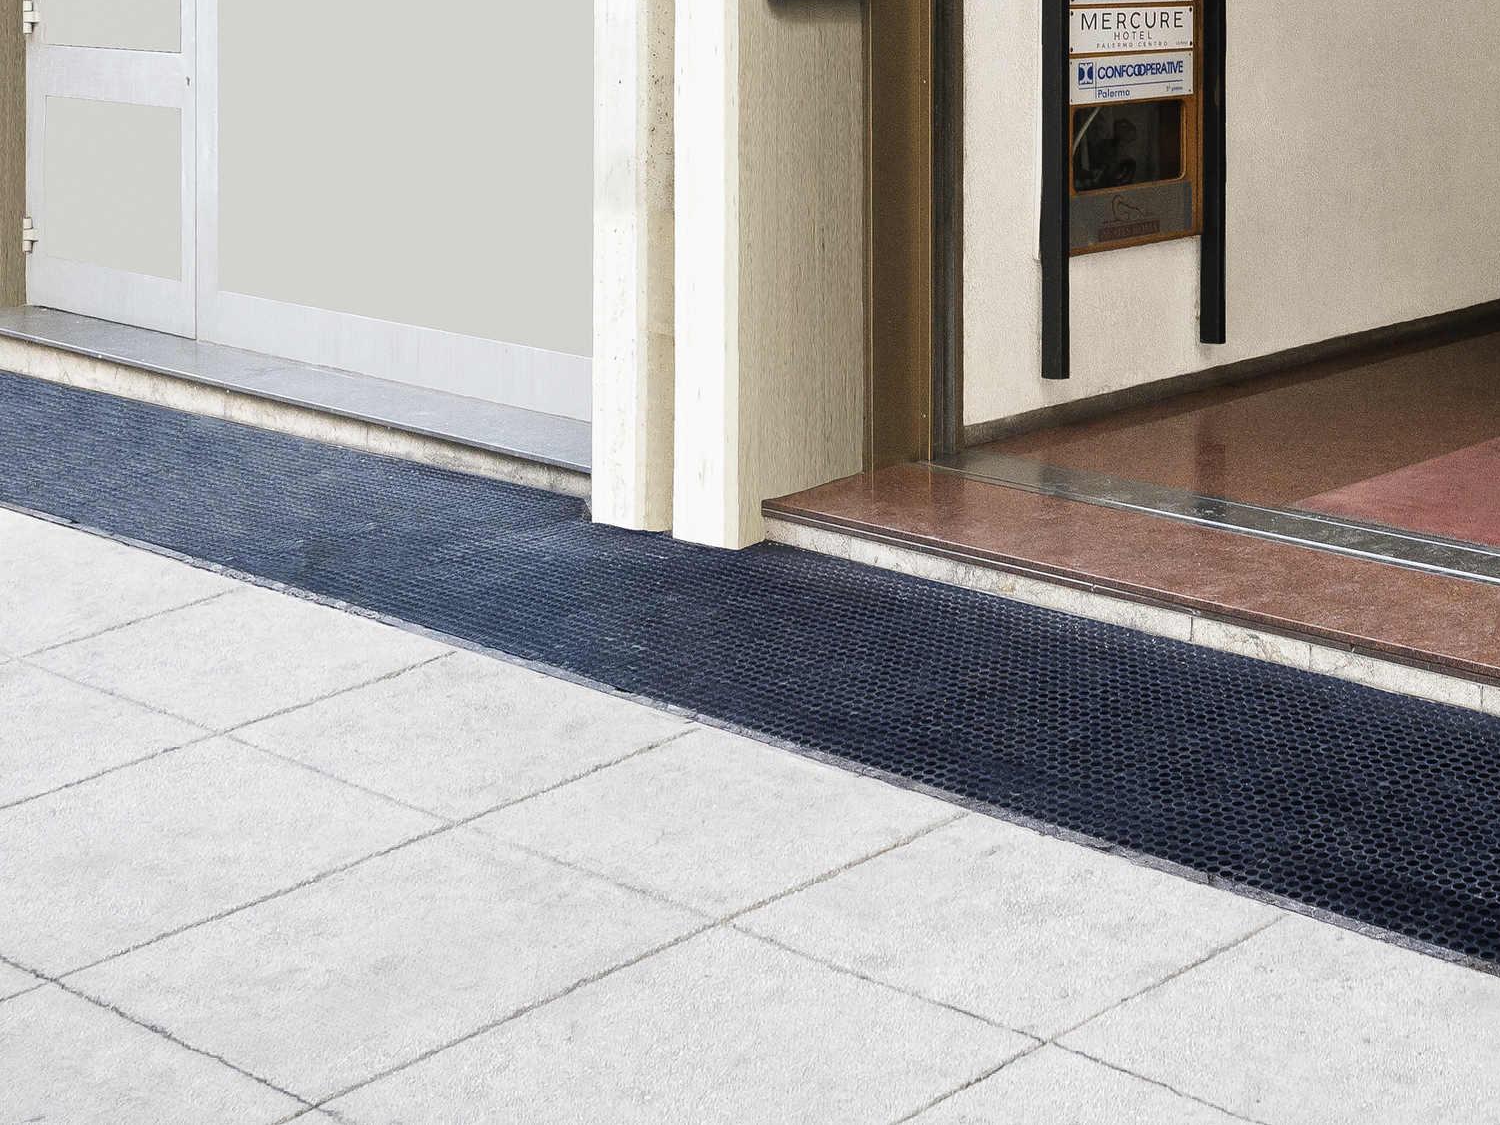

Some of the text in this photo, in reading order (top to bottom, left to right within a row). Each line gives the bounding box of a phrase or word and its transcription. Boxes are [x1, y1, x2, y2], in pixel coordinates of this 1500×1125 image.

[1081, 11, 1183, 30] MERCURE
[1113, 31, 1152, 40] HOTEL
[1097, 61, 1183, 80] CONFCOOPERATIVE
[1097, 89, 1130, 99] Palermo
